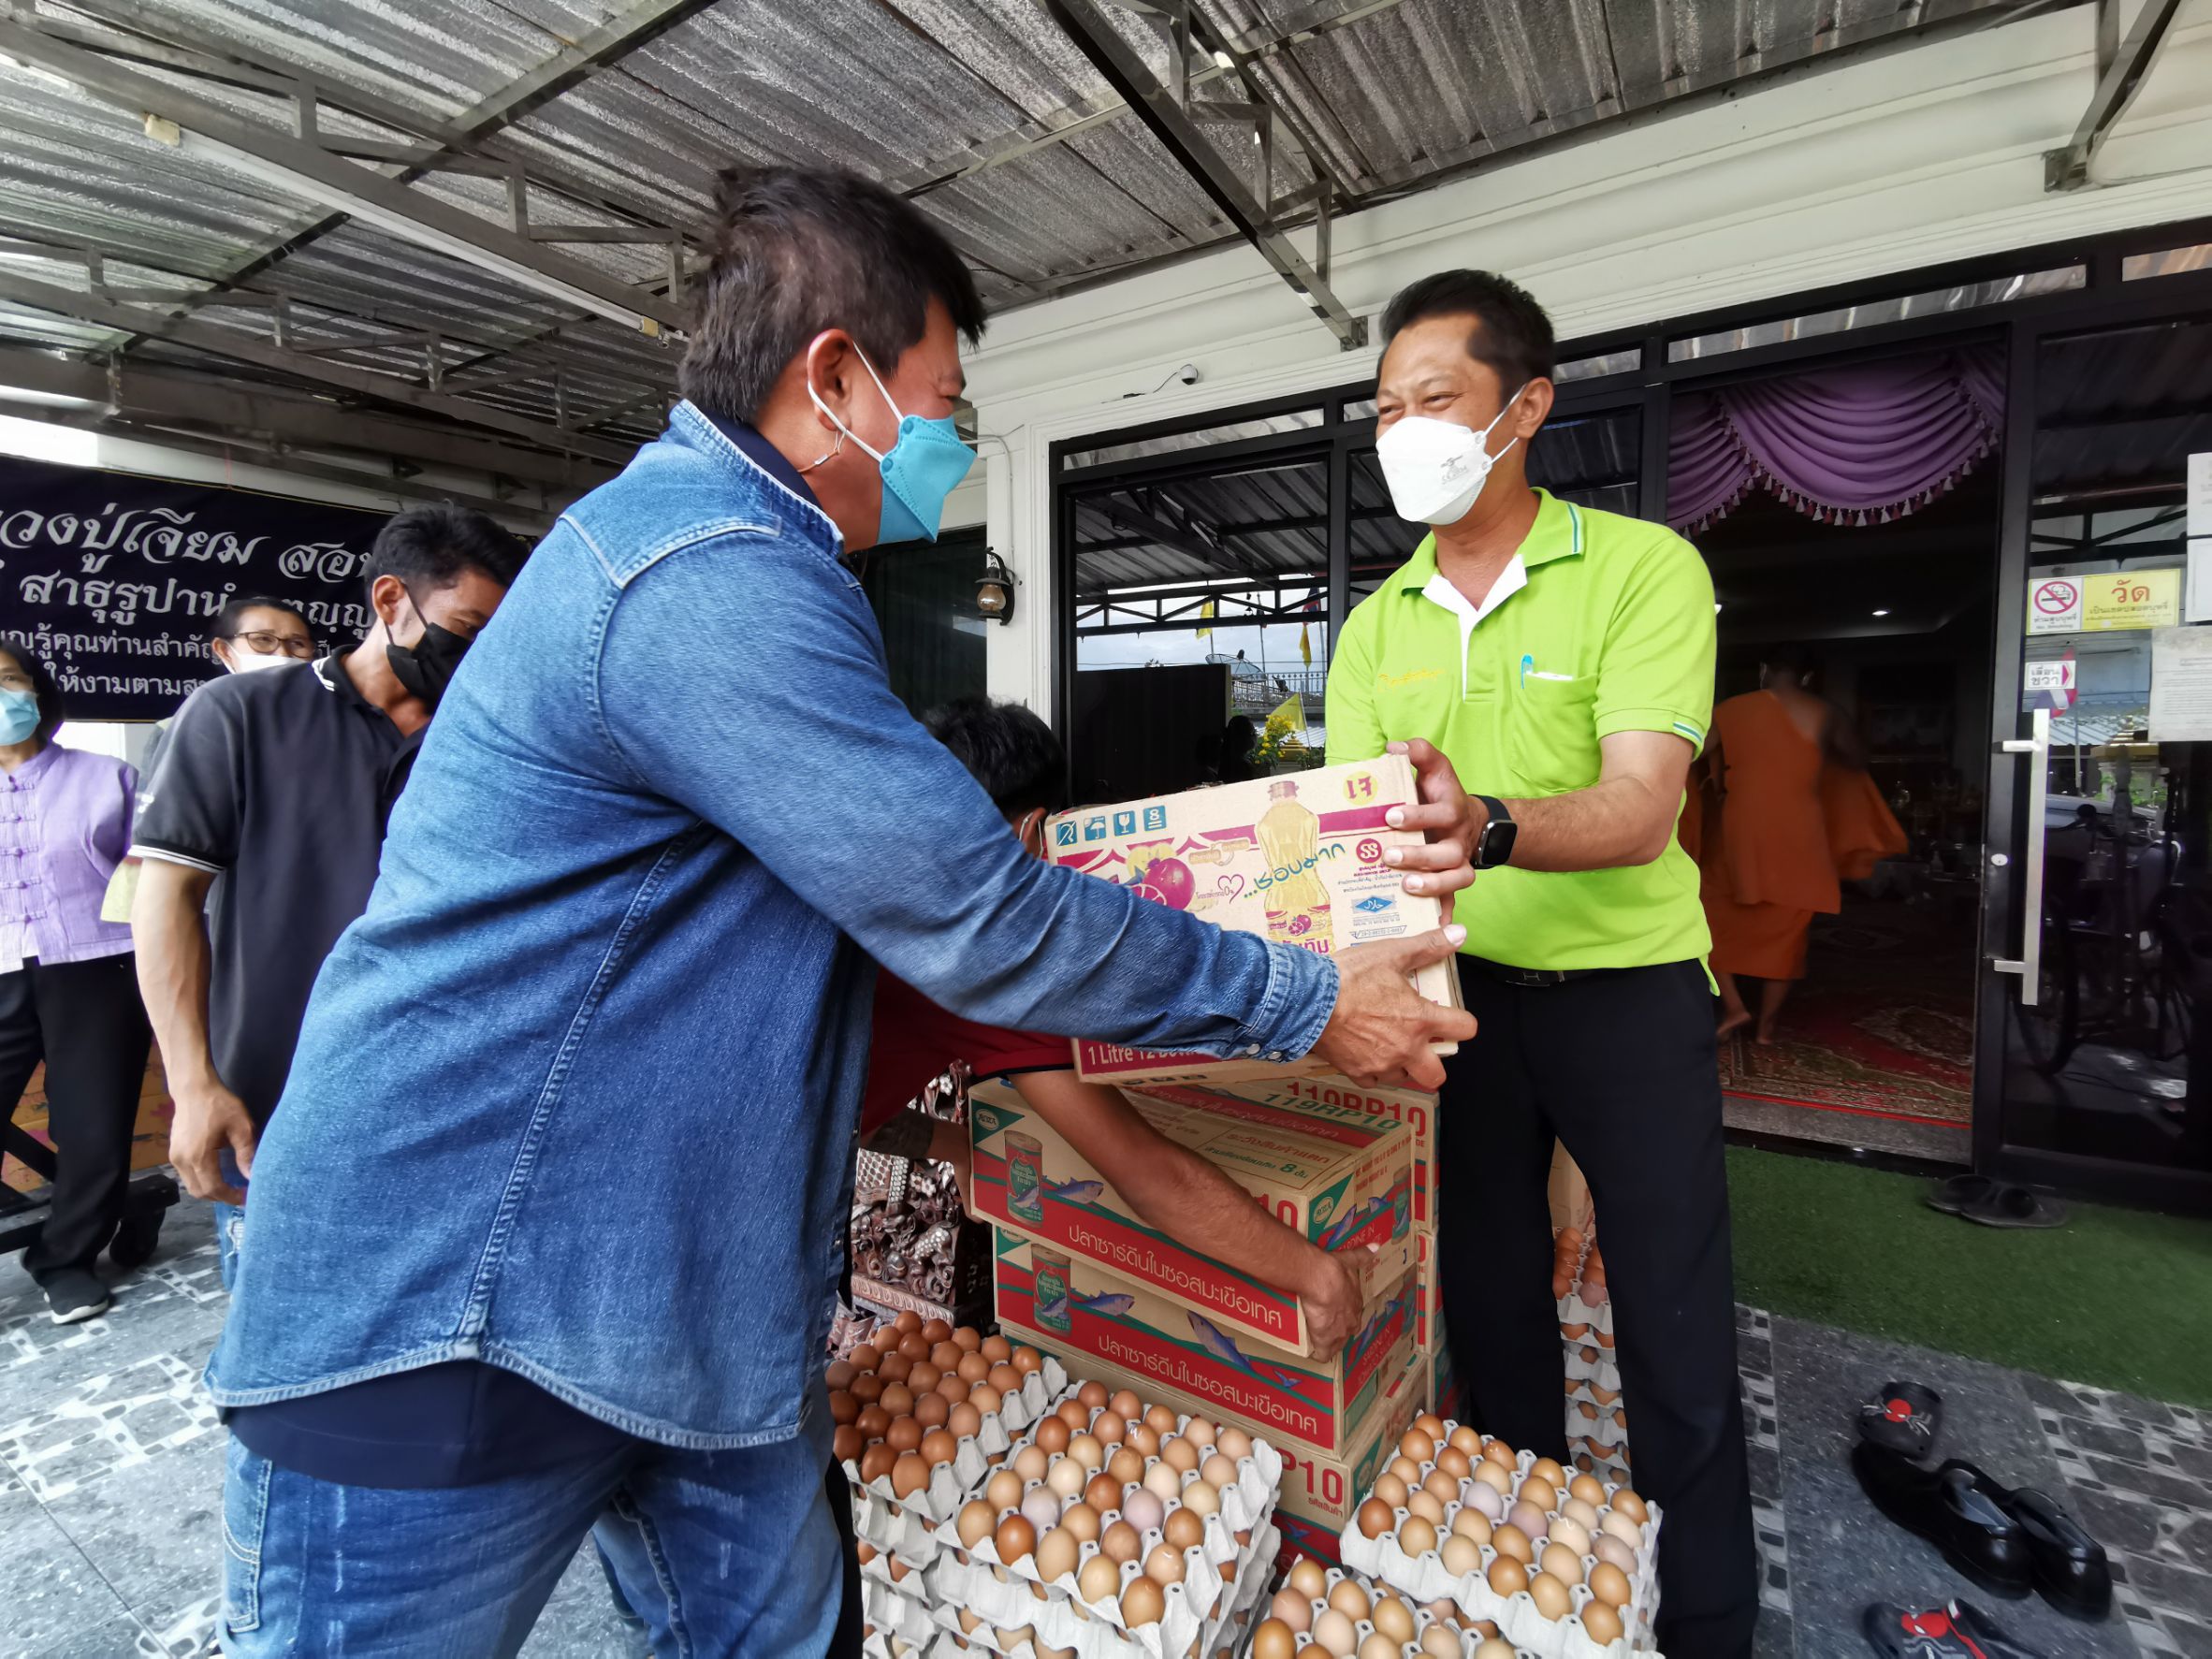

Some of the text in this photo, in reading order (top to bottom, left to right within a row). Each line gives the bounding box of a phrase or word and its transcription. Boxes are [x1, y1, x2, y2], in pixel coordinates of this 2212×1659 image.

[0, 502, 271, 574] วงปู่เจียม
[2111, 579, 2150, 604] วัด
[43, 661, 208, 697] ให้งามตามส
[1149, 808, 1159, 821] 8
[1360, 842, 1379, 859] SS
[1088, 1046, 1096, 1065] 1
[1099, 1043, 1134, 1065] Litre
[1263, 1093, 1402, 1130] 119RP10
[1279, 1163, 1297, 1173] 8
[1069, 1224, 1283, 1330] ปลาซาร์ดีนในซอสมะเขือเทศ
[1098, 1333, 1317, 1435] ปลาซาร์ดีนในซอสมะเขือเทศ
